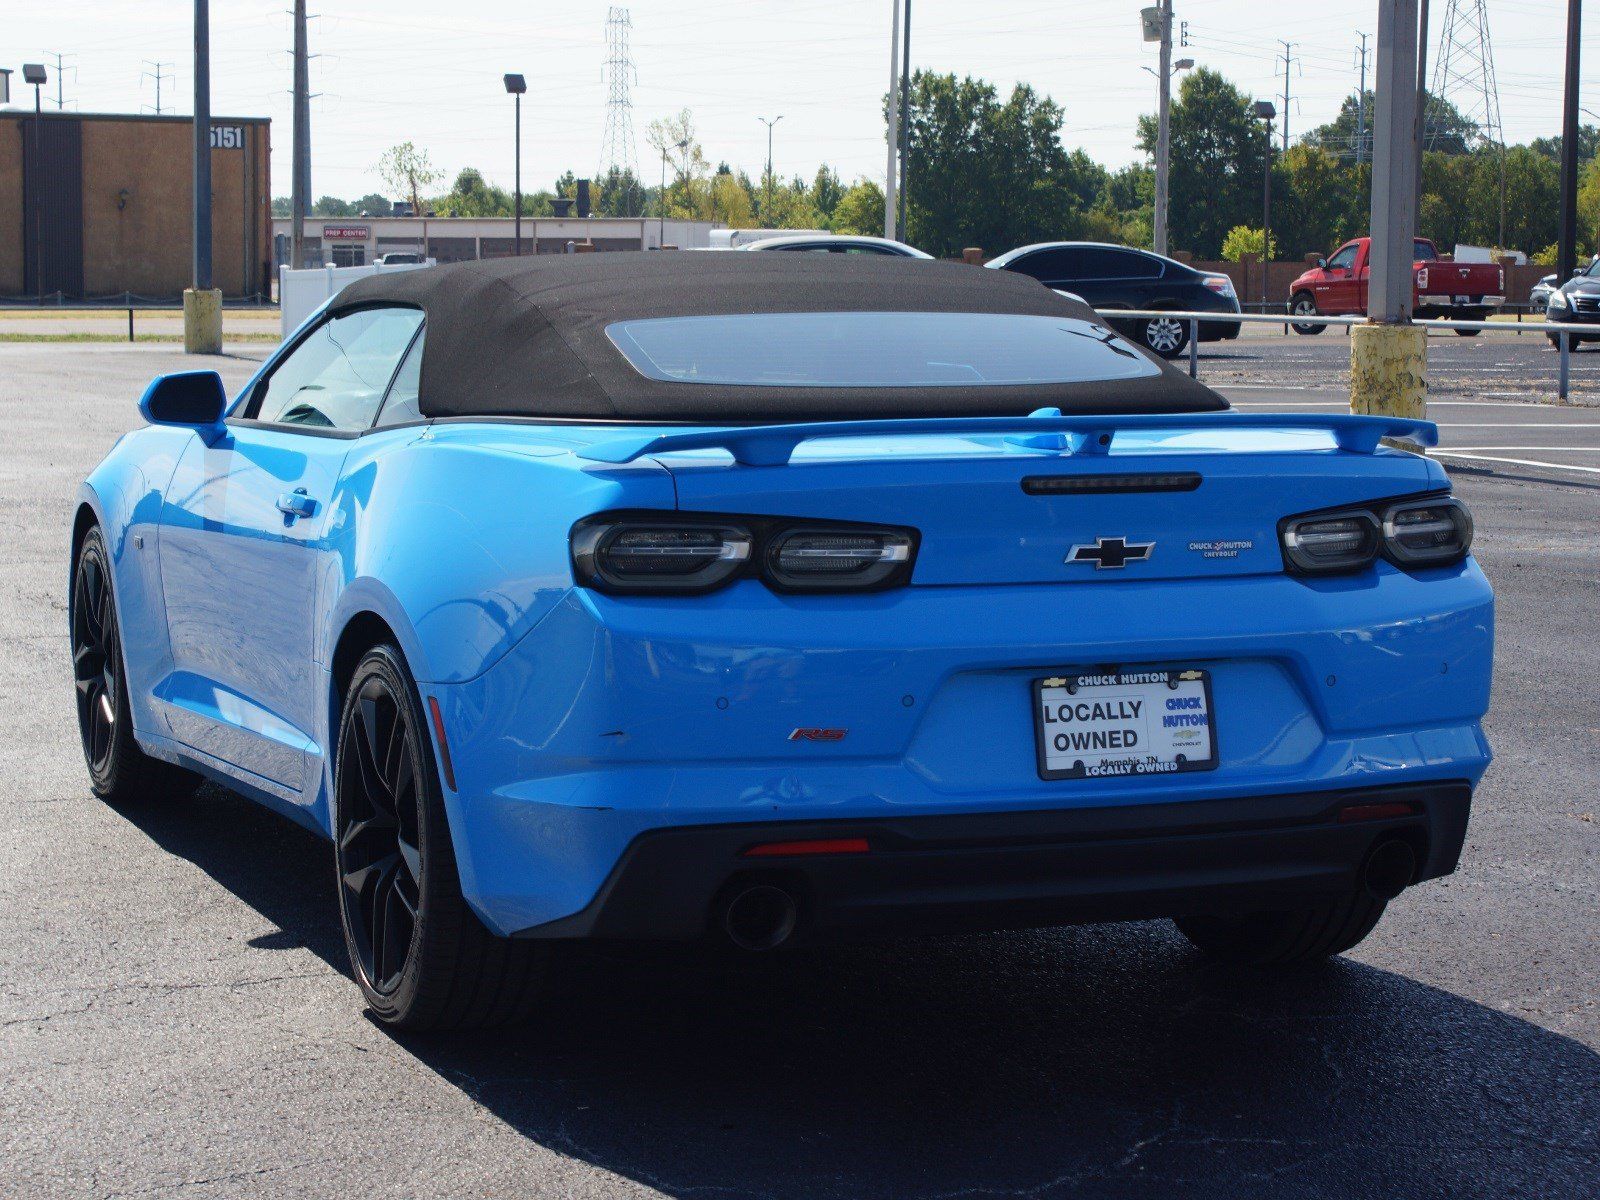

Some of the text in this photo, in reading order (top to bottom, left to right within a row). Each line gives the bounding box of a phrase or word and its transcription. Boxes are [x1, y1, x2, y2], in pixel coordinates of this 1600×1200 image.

[1189, 541, 1252, 550] CHUCK HUTTON
[1203, 550, 1238, 558] CHEVROLET
[1077, 671, 1169, 687] CHUCK HUTTON
[1165, 696, 1203, 710] CHUCK
[1044, 700, 1143, 724] LOCALLY
[1162, 713, 1208, 728] HUTTON
[786, 727, 849, 741] RS
[1053, 729, 1138, 752] OWNED
[1145, 755, 1159, 764] TN
[1084, 761, 1178, 777] LOCALLY OWNED
